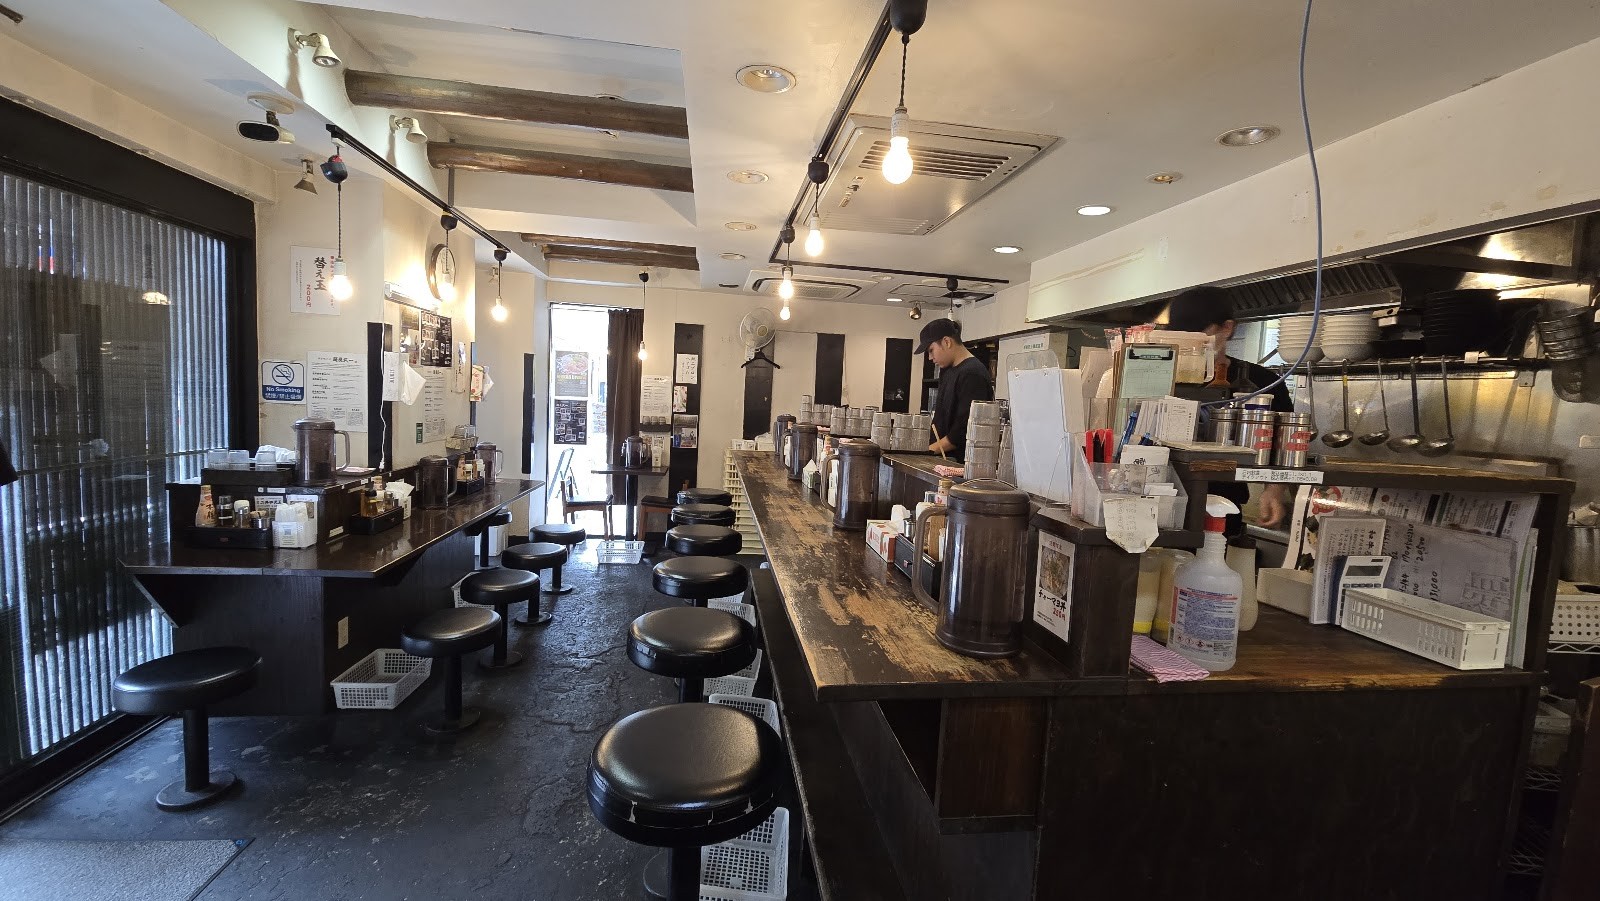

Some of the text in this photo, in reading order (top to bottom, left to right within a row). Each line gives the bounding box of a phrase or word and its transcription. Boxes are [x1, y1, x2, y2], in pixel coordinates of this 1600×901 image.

[313, 256, 327, 291] 替え玉
[275, 386, 301, 394] Smoking
